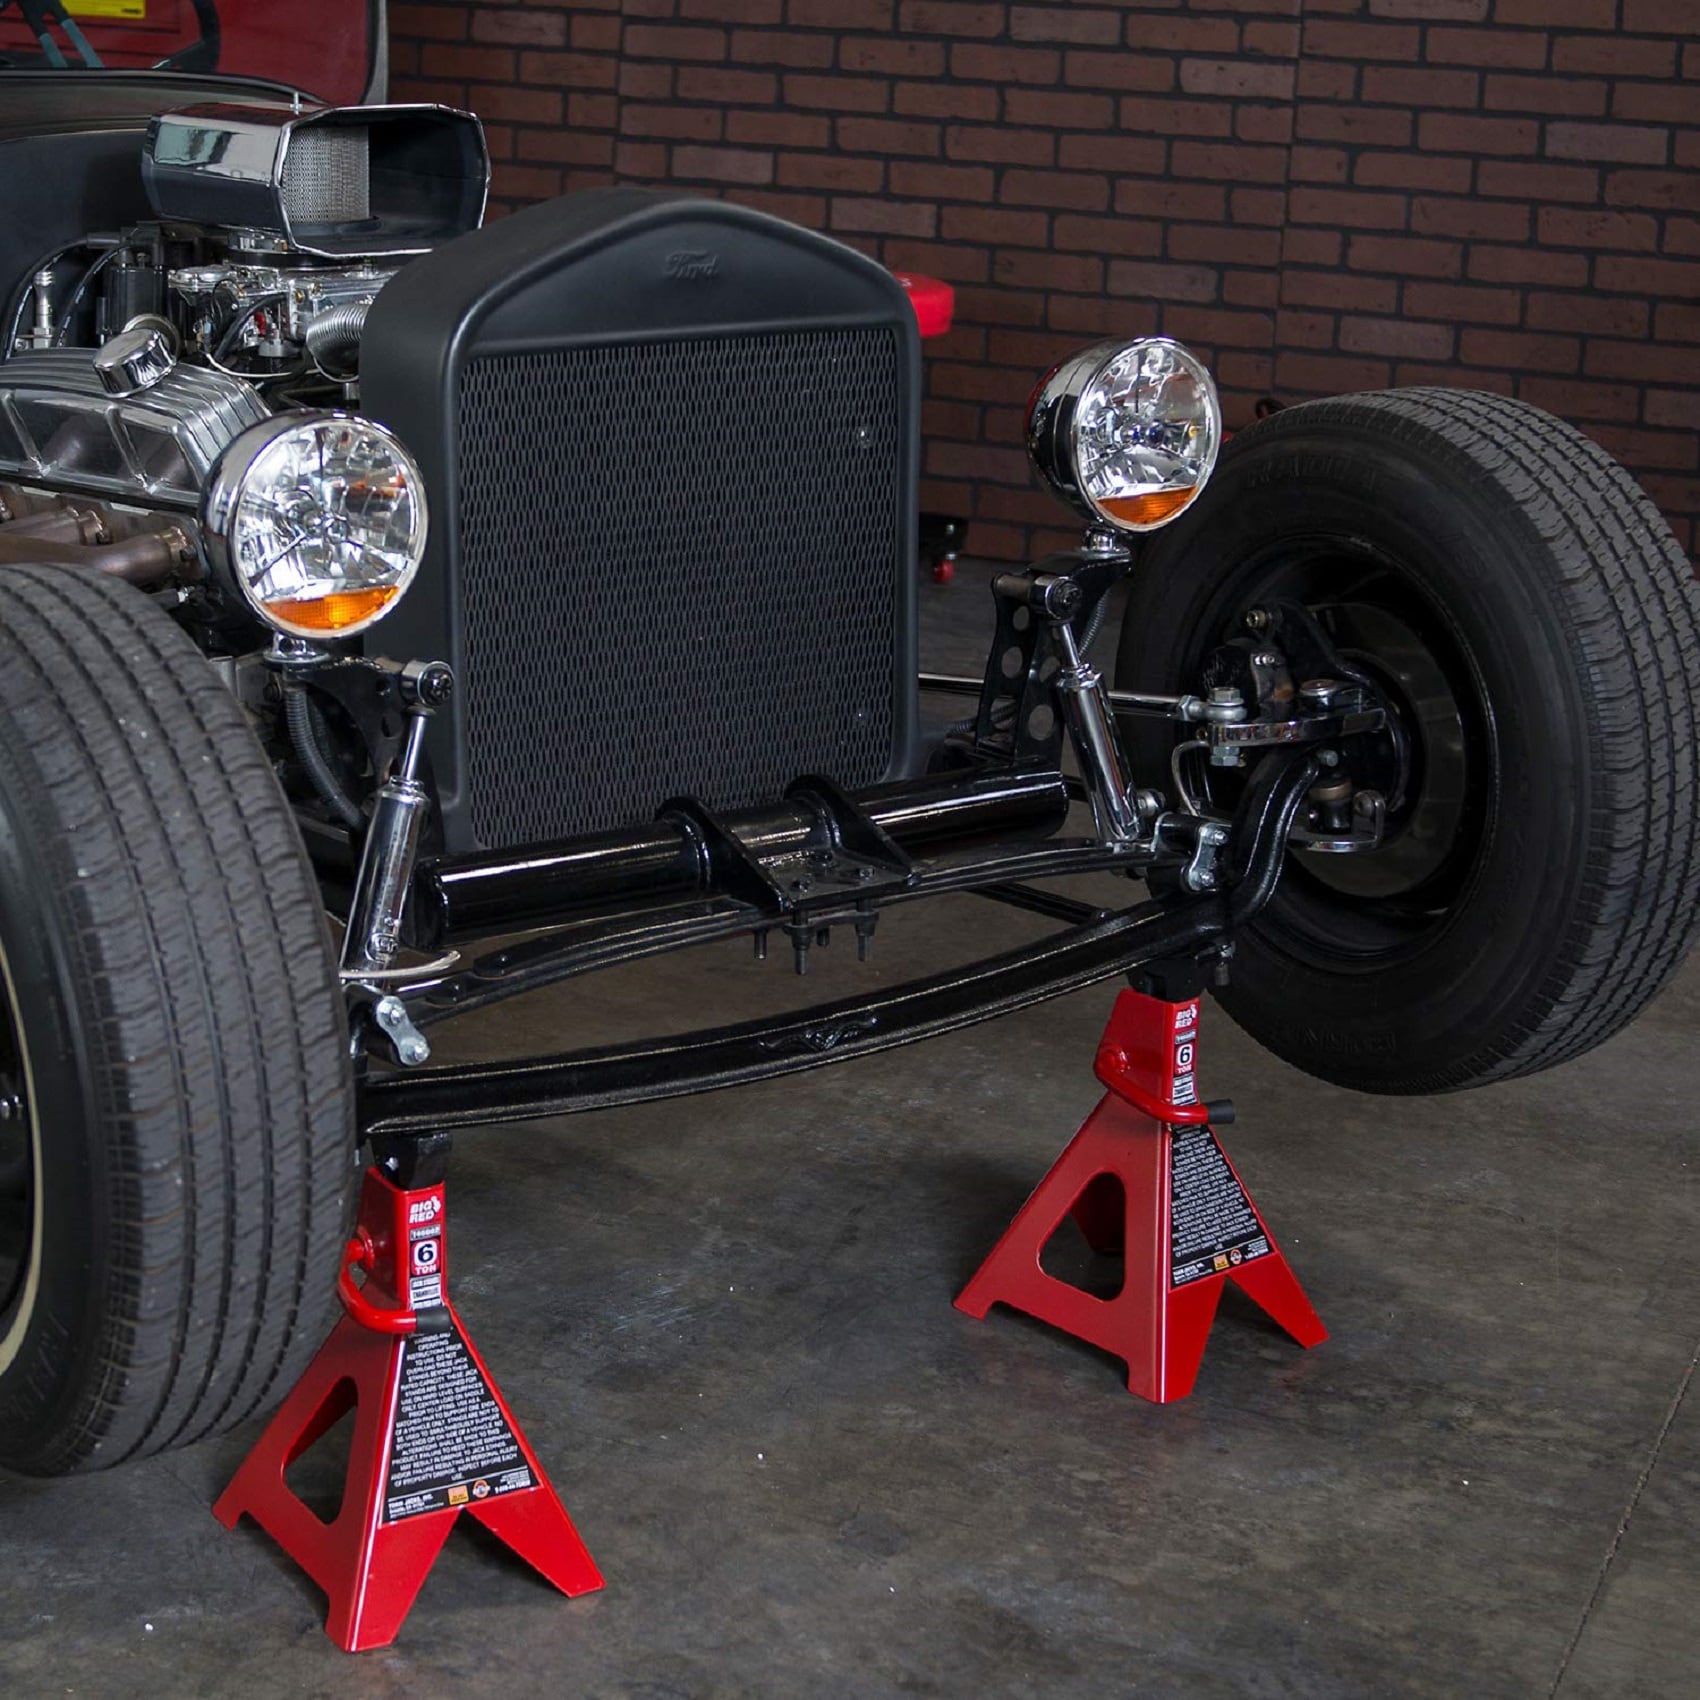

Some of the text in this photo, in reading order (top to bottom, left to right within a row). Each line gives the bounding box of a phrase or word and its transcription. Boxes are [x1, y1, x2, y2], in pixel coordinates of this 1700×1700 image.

[662, 249, 719, 278] Ford
[1180, 1046, 1191, 1064] 6
[411, 1201, 432, 1214] BIG
[409, 1211, 434, 1224] RED
[417, 1244, 434, 1264] 6
[415, 1264, 437, 1276] TON
